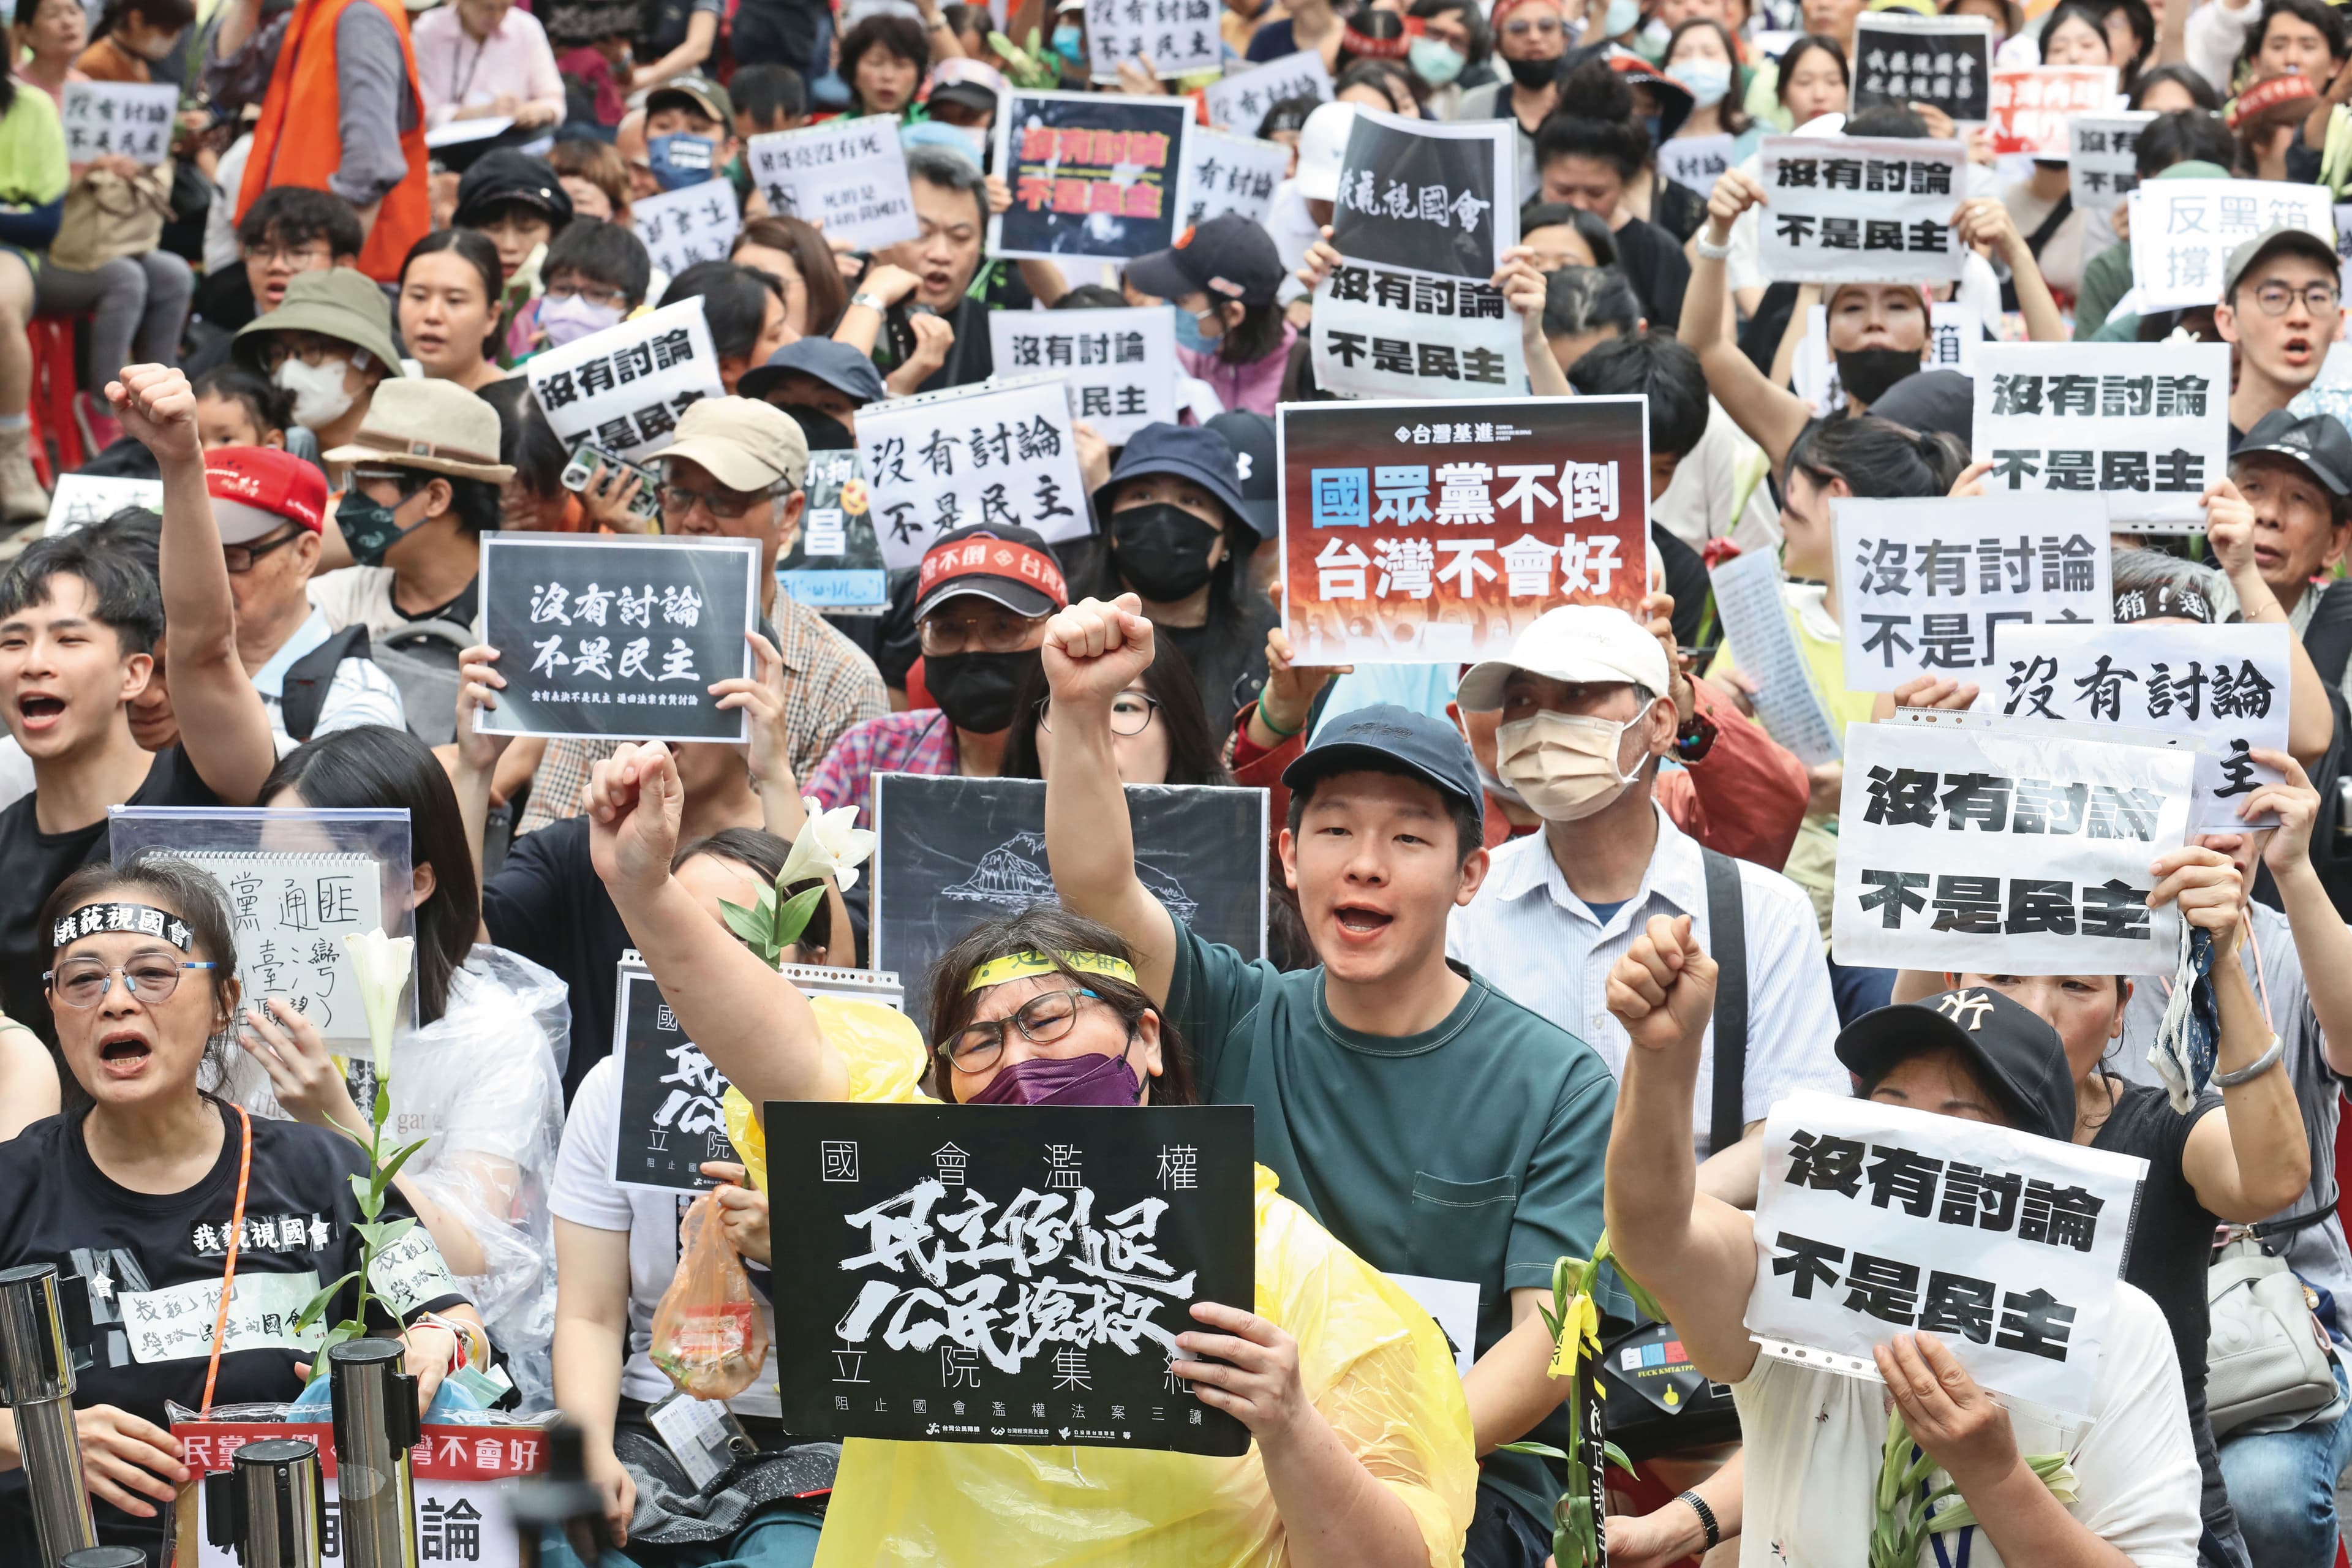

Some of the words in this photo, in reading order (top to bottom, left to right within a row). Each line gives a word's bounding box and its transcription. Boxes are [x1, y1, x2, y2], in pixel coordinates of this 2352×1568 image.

[66, 96, 168, 125] 沒有討論
[67, 128, 162, 153] 不是民主
[1777, 158, 1954, 195] 沒有討論
[1777, 214, 1949, 254] 不是民主
[2167, 195, 2310, 235] 反黑箱
[1329, 263, 1505, 320] 沒有討論
[537, 328, 695, 413] 沒有討論
[1012, 331, 1146, 367] 沒有討論
[1327, 329, 1507, 385] 不是民主
[1070, 385, 1148, 417] 民主
[1991, 373, 2211, 418] 沒有討論
[872, 415, 1061, 489] 沒有討論
[1412, 423, 1494, 444] 台灣基進
[1311, 461, 1619, 529] 國眾黨不倒
[1991, 447, 2205, 492] 不是民主
[883, 475, 1074, 546] 不是民主
[919, 545, 987, 587] 黨不倒
[1314, 533, 1623, 601] 台灣不會好
[1855, 533, 2097, 598] 沒有討論
[530, 581, 703, 629] 沒有討論
[529, 634, 701, 682] 不是民主
[2003, 654, 2276, 723] 沒有討論
[1863, 764, 2168, 843] 沒有討論
[56, 905, 192, 948] 我藐視國會
[230, 871, 360, 933] 黨通匪
[1857, 869, 2152, 941] 不是民主
[240, 937, 341, 998] 臺灣
[821, 1140, 1199, 1191] 國會濫權
[1783, 1128, 2106, 1253] 沒有討論
[839, 1176, 1197, 1300] 民主倒退
[89, 1270, 115, 1298] 會
[1771, 1231, 2078, 1363] 不是民主
[837, 1273, 1200, 1374] 公民搶救
[1637, 1366, 1658, 1378] FUCK
[835, 1395, 1203, 1427] 阻止國會濫權法案三讀
